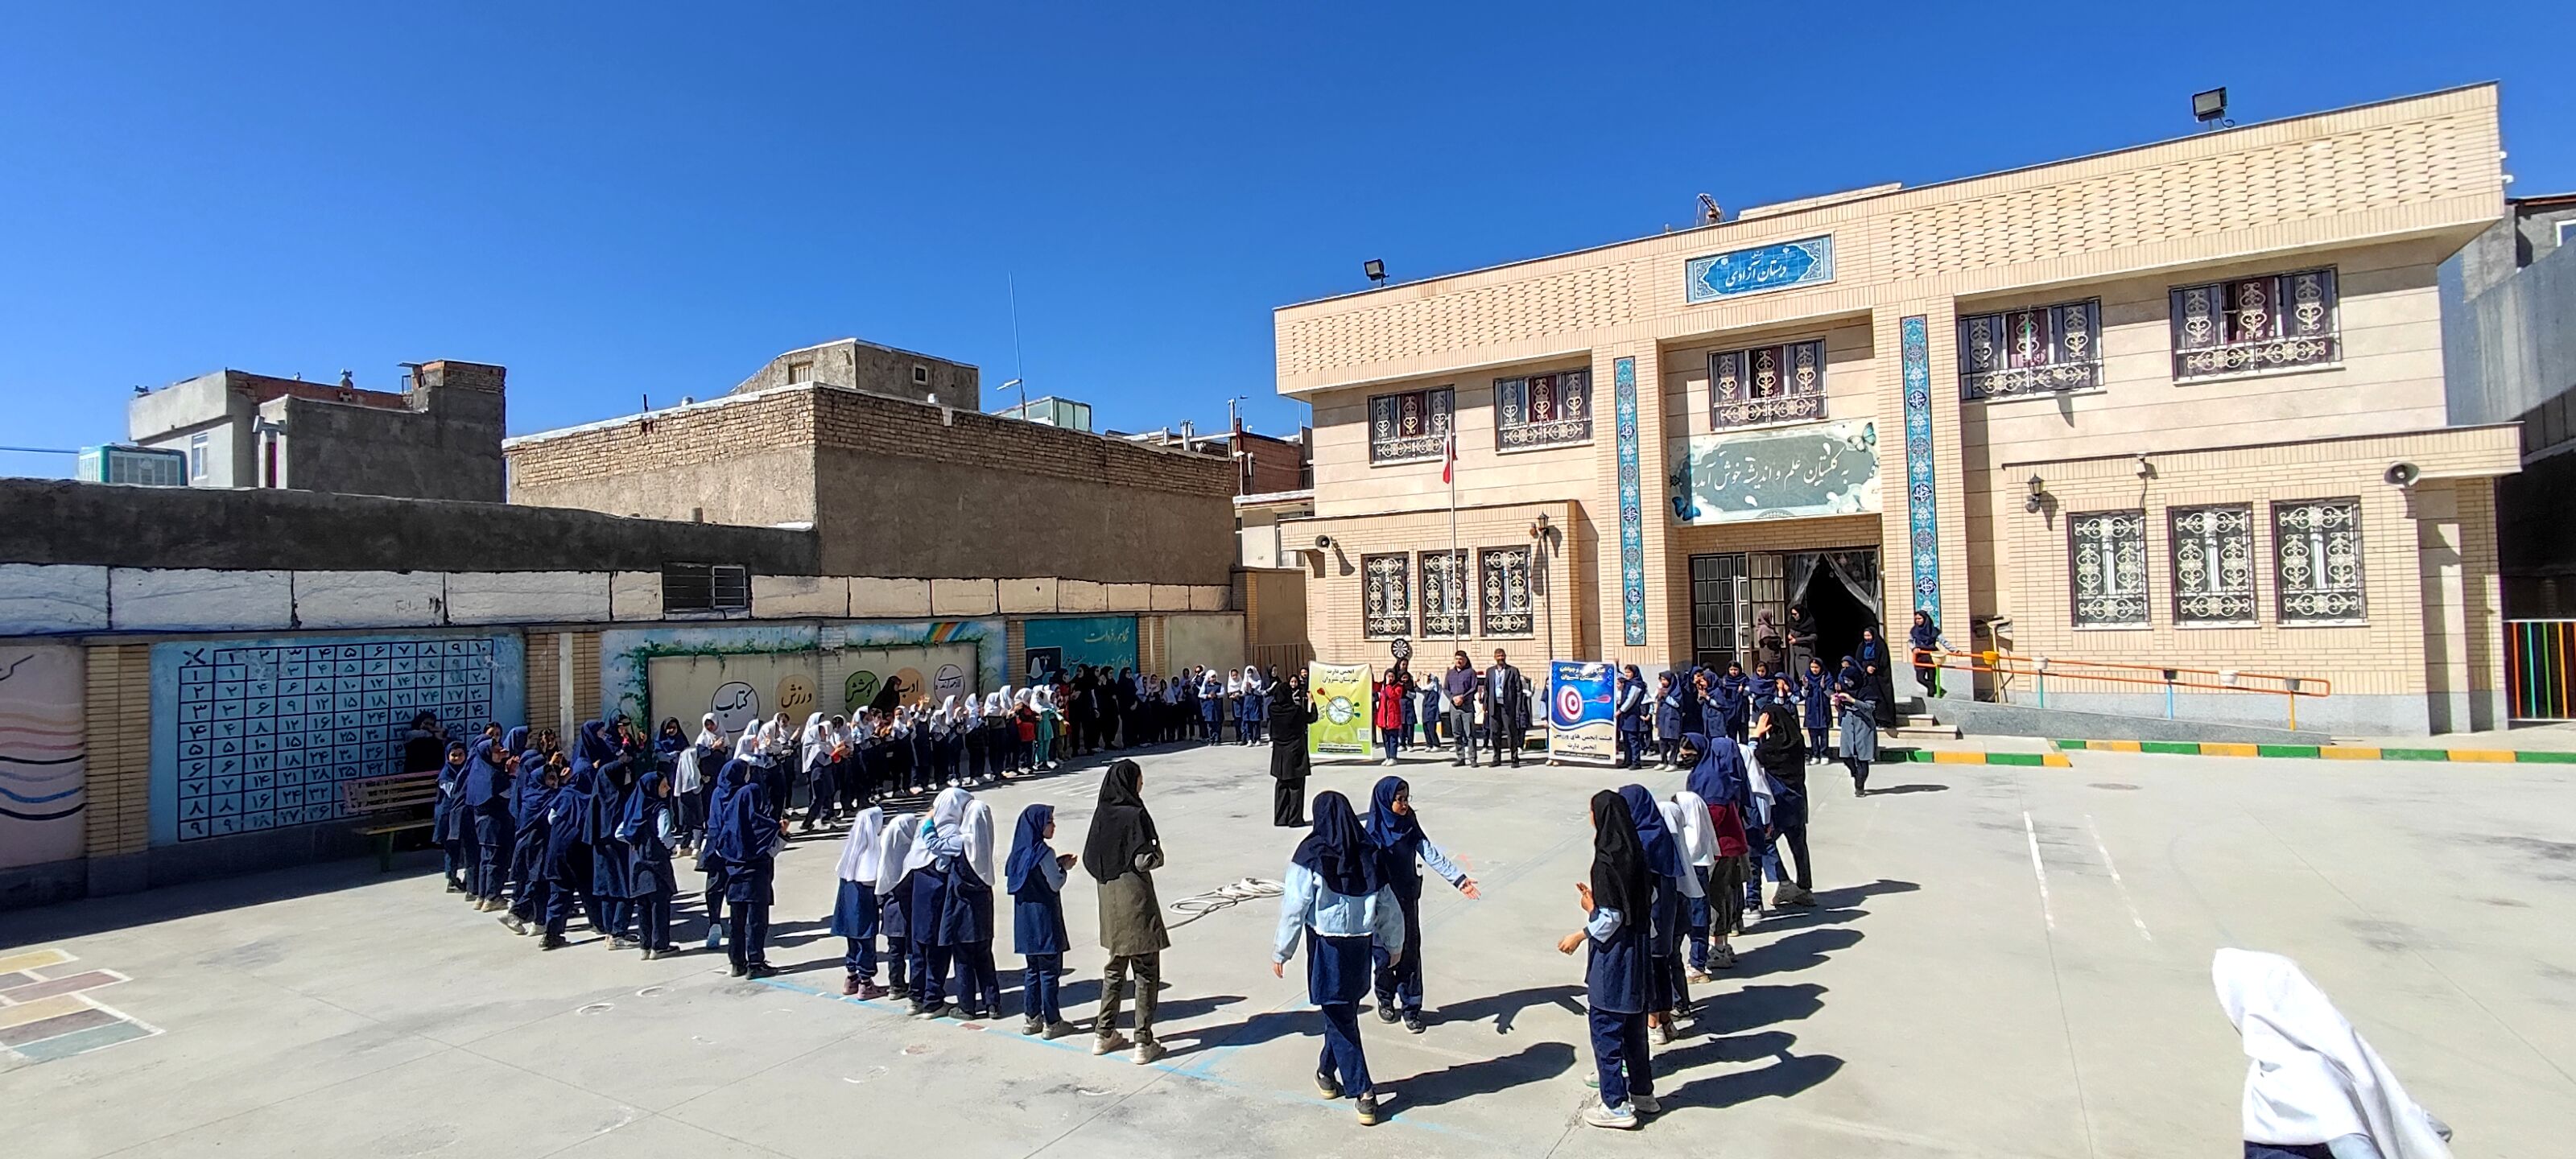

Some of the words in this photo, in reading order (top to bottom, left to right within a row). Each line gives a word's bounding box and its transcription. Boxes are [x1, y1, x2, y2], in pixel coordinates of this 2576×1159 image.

[1725, 259, 1761, 287] آزادی
[1757, 259, 1786, 282] دبستان
[1714, 460, 1741, 491] خوش
[1743, 456, 1772, 489] اندیشه
[1775, 469, 1781, 481] و
[1783, 459, 1802, 491] علم
[1803, 446, 1846, 485] گلستان
[1841, 468, 1849, 485] به
[229, 654, 233, 663] ۱
[260, 650, 270, 658] ۲
[320, 648, 332, 659] ۴
[345, 647, 357, 658] ۵
[374, 646, 385, 657] ۶
[398, 645, 410, 654] ۷
[424, 645, 437, 654] ۸
[452, 643, 461, 654] ۹
[476, 643, 486, 652] ۱۰
[194, 670, 197, 680] ۱
[229, 669, 235, 678] ۱
[287, 666, 299, 675] ۳
[318, 664, 328, 674] ۴
[345, 664, 356, 672] ۵
[372, 662, 383, 671] ۶
[399, 662, 409, 670] ۷
[194, 686, 204, 699] ۲
[226, 686, 237, 696] ۲
[257, 683, 267, 695] ۴
[287, 682, 298, 692] ۶
[315, 682, 328, 691] ۸
[344, 681, 356, 689] ۱۰
[371, 678, 384, 688] ۱۲
[398, 677, 411, 686] ۱۴
[423, 674, 436, 684] ۱۶
[473, 673, 486, 682] ۲۰
[781, 684, 812, 708] ورزش
[898, 678, 919, 699] ادب
[193, 705, 207, 719] ۳
[222, 705, 236, 716] ۳
[256, 702, 270, 714] ۶
[287, 700, 296, 711] ۹
[316, 698, 329, 710] ۱۲
[345, 697, 357, 707] ۱۵
[372, 695, 387, 707] ۱۸
[397, 693, 411, 704] ۲۱
[421, 691, 439, 702] ۲۴
[471, 689, 481, 699] ۳۰
[716, 688, 753, 718] کتاب
[189, 725, 207, 739] ۴
[224, 724, 235, 735] ۴
[255, 722, 268, 733] ۸
[286, 720, 299, 731] ۱۲
[314, 716, 331, 728] ۱۶
[341, 715, 353, 725] ۲۰
[368, 712, 386, 723] ۲۴
[395, 711, 411, 721] ۲۸
[445, 706, 463, 716] ۳۶
[472, 705, 484, 716] ۴۰
[189, 744, 204, 755] ۵
[223, 741, 235, 753] ۵
[255, 740, 266, 750] ۱۰
[286, 736, 301, 747] ۱۵
[314, 733, 324, 744] ۲۰
[341, 732, 357, 742] ۲۵
[366, 729, 378, 740] ۳۰
[471, 722, 482, 731] ۵
[188, 762, 205, 777] ۶
[221, 761, 235, 773] ۶
[254, 756, 268, 769] ۱۲
[285, 755, 300, 765] ۱۸
[310, 751, 328, 763] ۲۴
[340, 749, 352, 761] ۳۰
[365, 747, 383, 758] ۳۶
[189, 783, 204, 794] ۷
[221, 779, 233, 790] ۷
[254, 775, 270, 787] ۱۴
[283, 772, 296, 784] ۲۱
[312, 769, 331, 780] ۲۸
[338, 767, 357, 777] ۳۵
[366, 763, 383, 774] ۴۲
[189, 801, 204, 815] ۸
[219, 798, 233, 812] ۸
[253, 794, 270, 808] ۱۶
[283, 790, 302, 803] ۲۴
[309, 787, 328, 800] ۳۲
[191, 822, 202, 834] ۹
[224, 819, 233, 831] ۹
